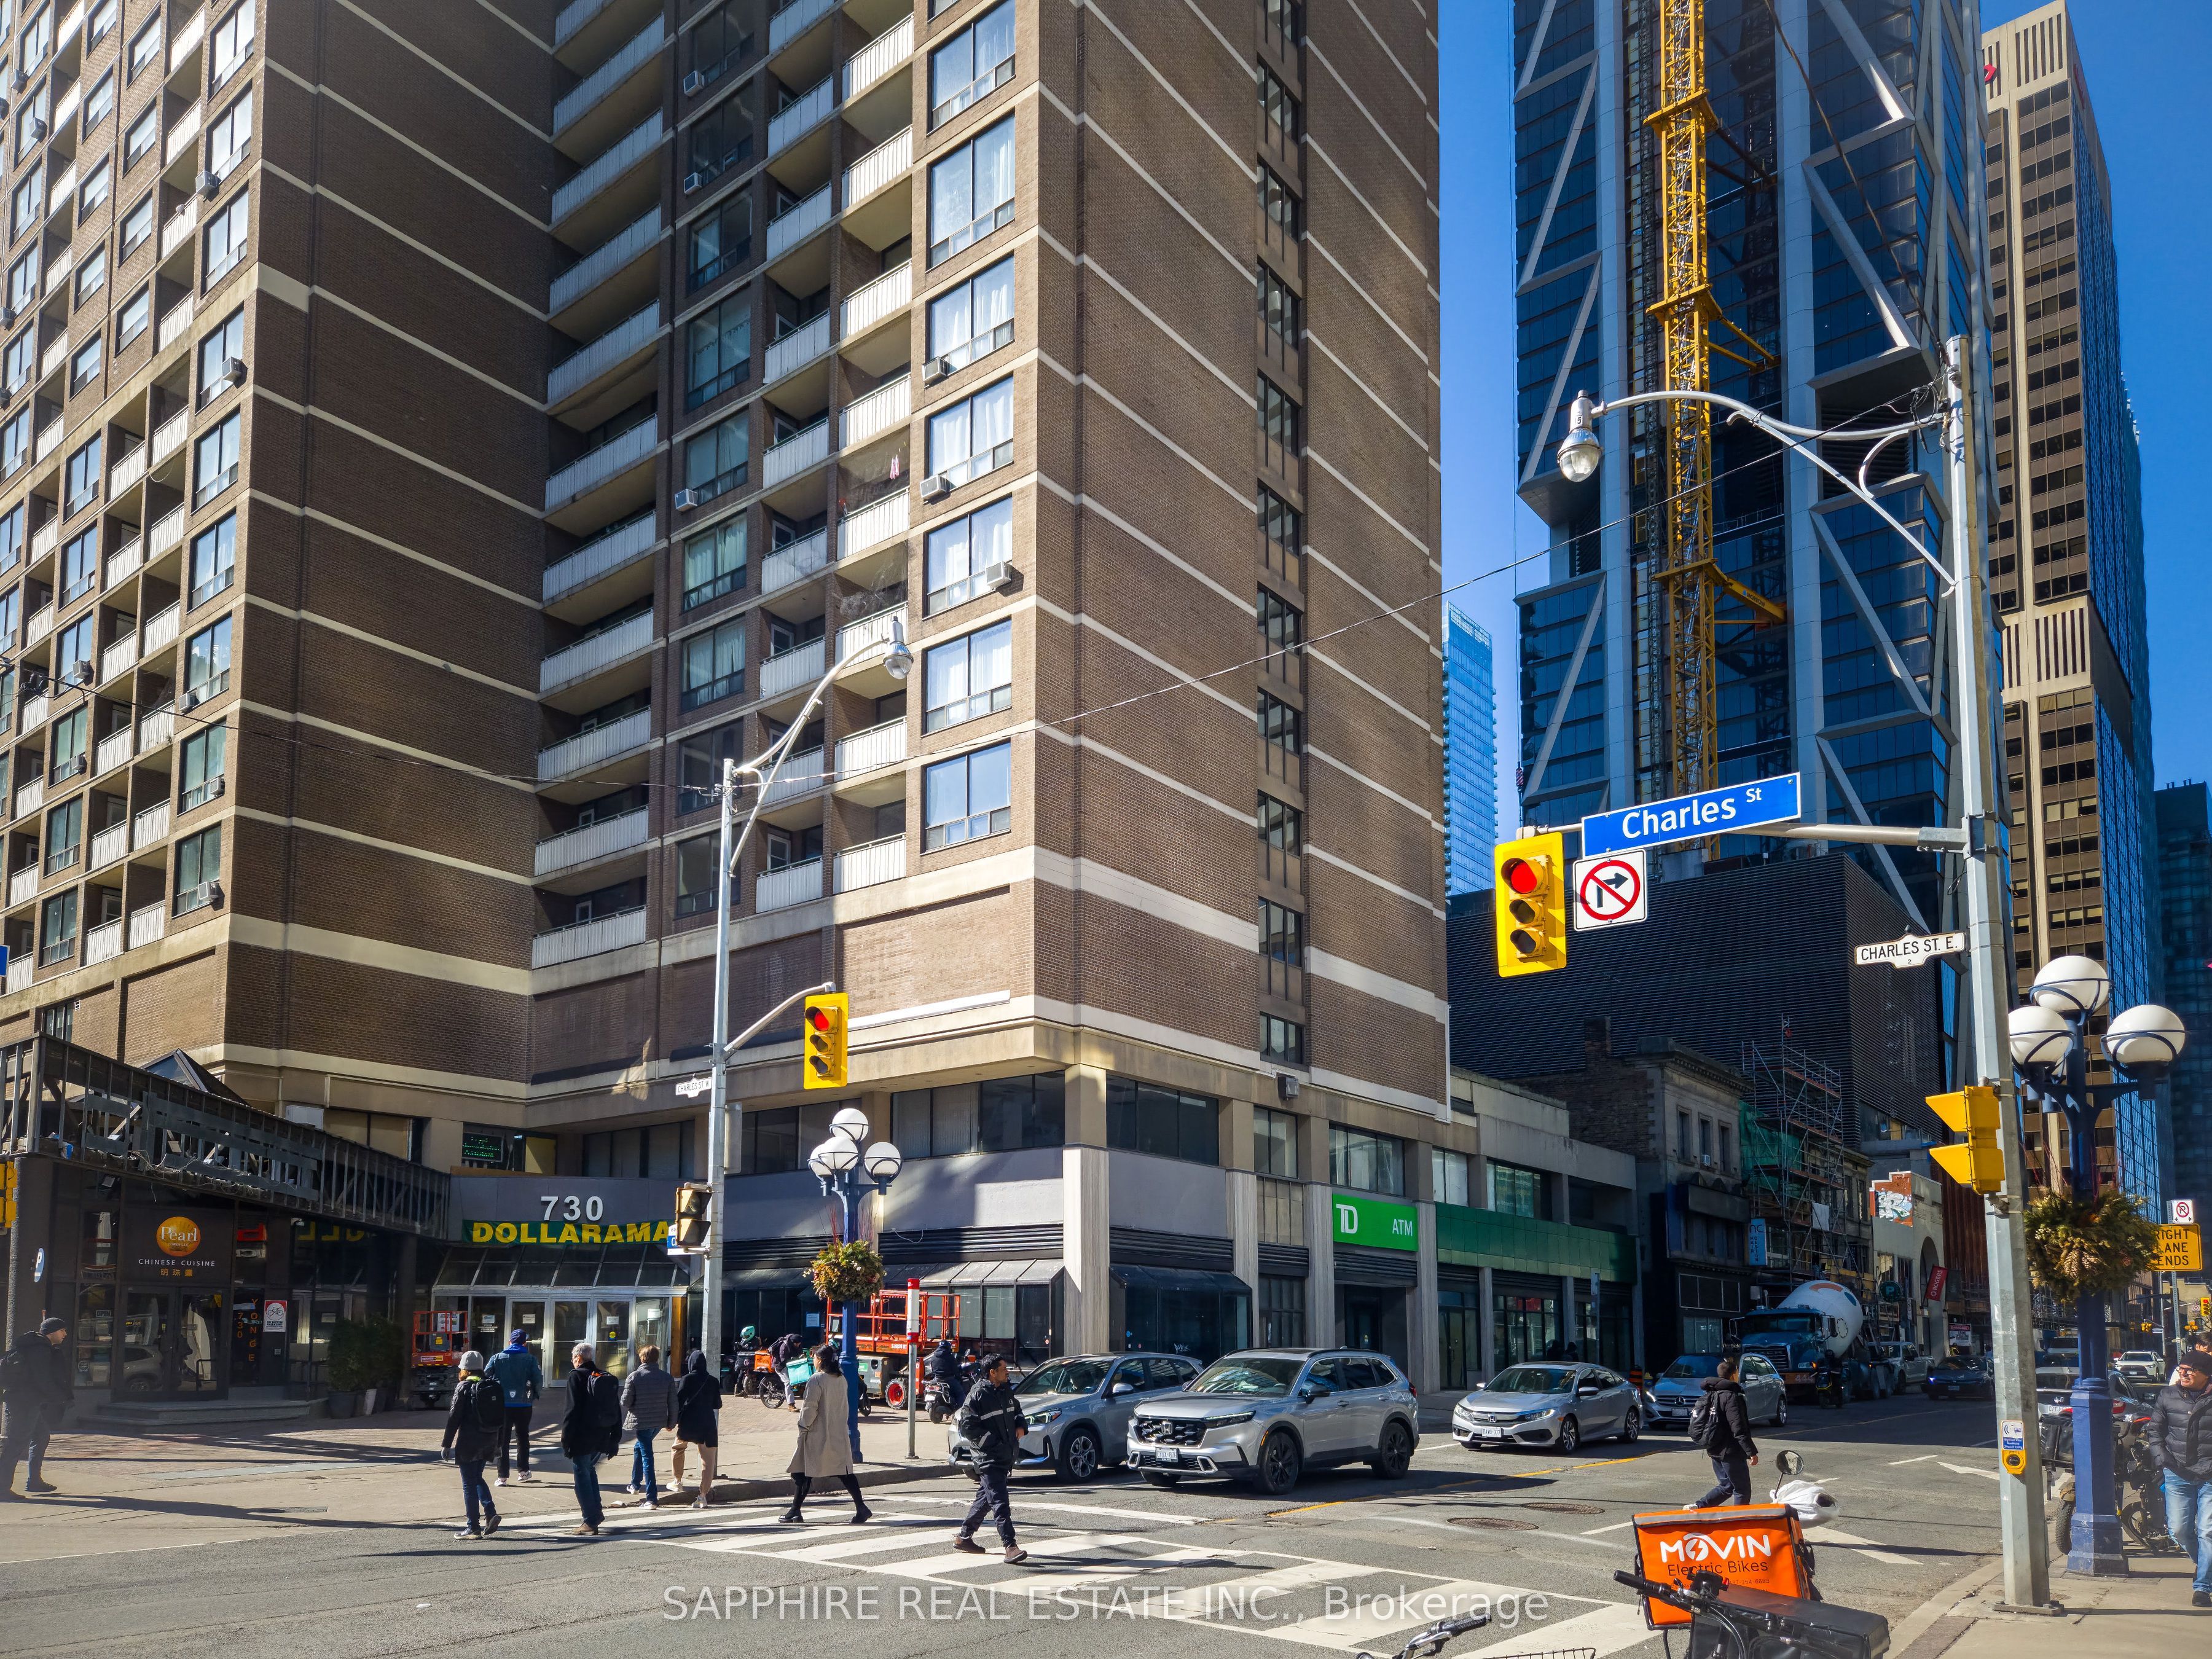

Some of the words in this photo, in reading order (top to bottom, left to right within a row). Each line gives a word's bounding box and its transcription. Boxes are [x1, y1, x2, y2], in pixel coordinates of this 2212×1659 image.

[1622, 798, 1736, 839] Charles
[1746, 787, 1762, 803] St
[1861, 941, 1919, 961] CHARLES
[1923, 938, 1940, 952] ST.
[1945, 936, 1958, 949] E.
[678, 1083, 697, 1092] CHARLES
[541, 1196, 603, 1221] 730
[1336, 1203, 1359, 1234] TD
[1392, 1218, 1413, 1237] ATM
[160, 1226, 198, 1242] Pearl
[472, 1220, 669, 1244] DOLLARAMA
[2155, 1229, 2189, 1240] RIGHT
[2163, 1242, 2189, 1253] ANE
[2157, 1255, 2189, 1266] ENDS
[248, 1298, 259, 1361] YONGE
[1660, 1532, 1771, 1563] MOVIN
[1668, 1562, 1723, 1577] Electric
[1727, 1561, 1768, 1574] Bikes
